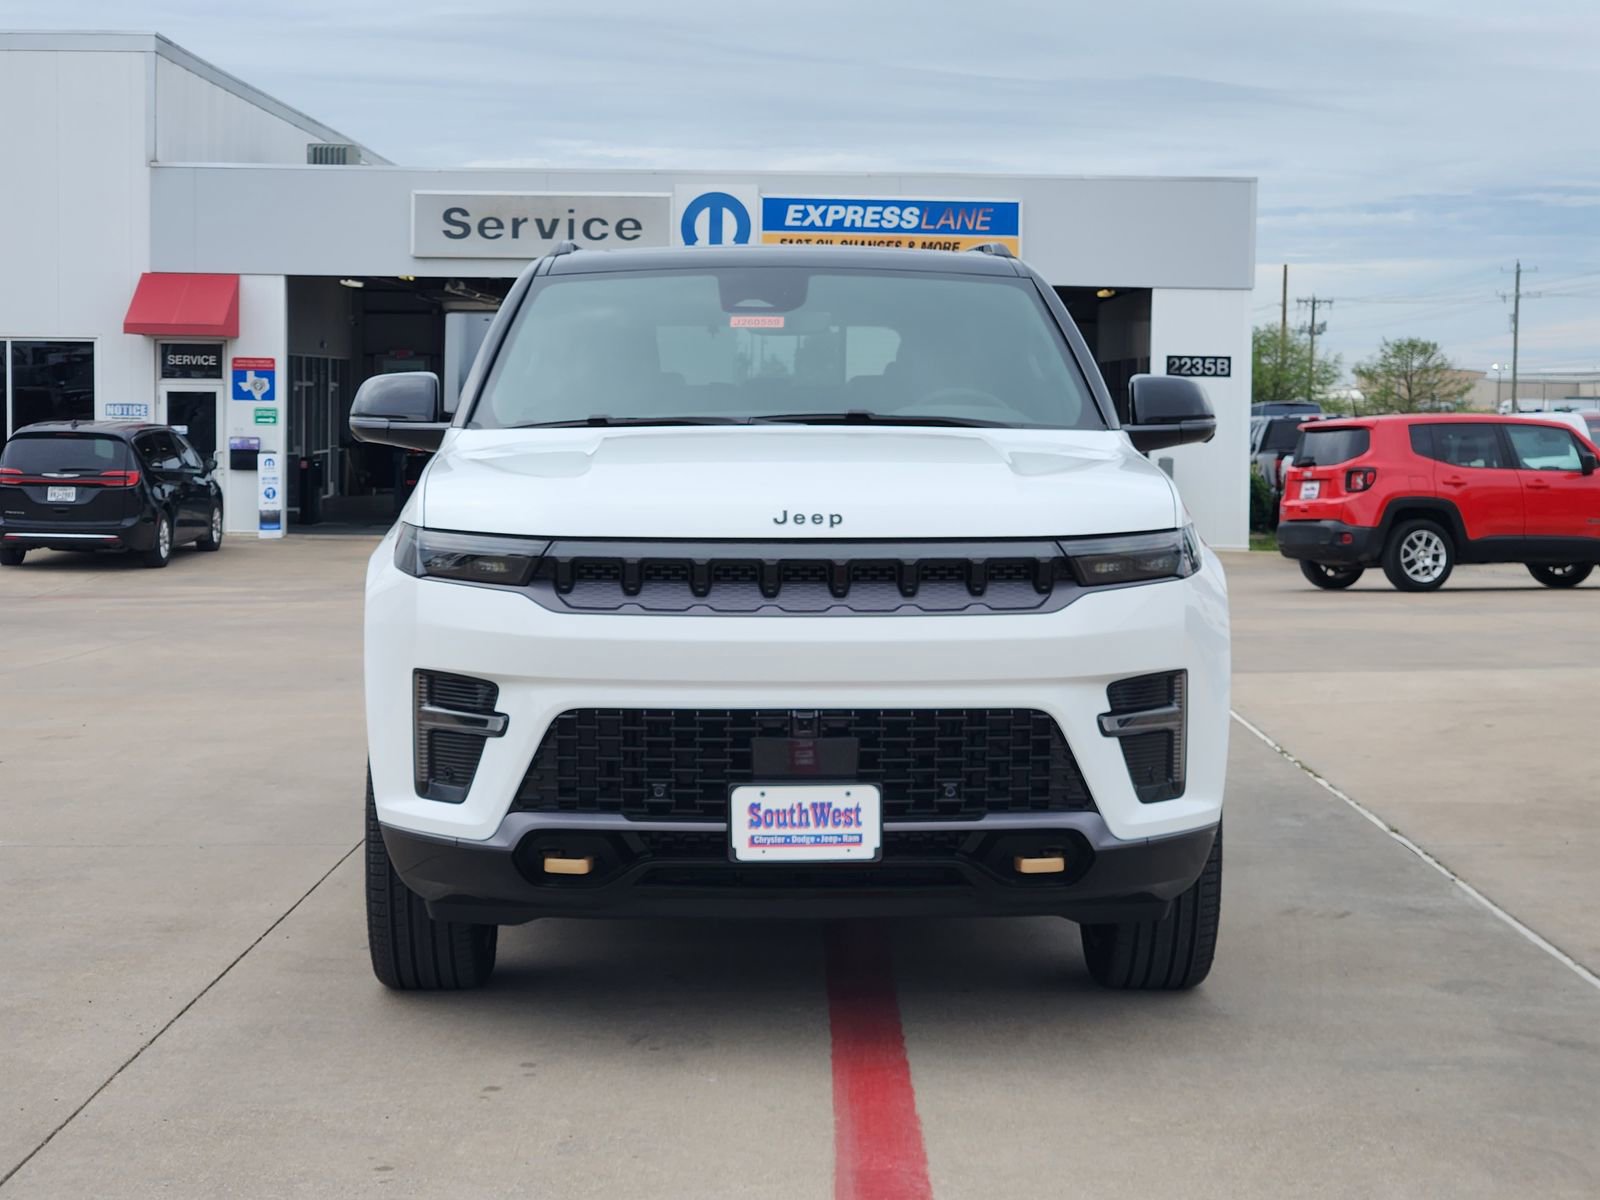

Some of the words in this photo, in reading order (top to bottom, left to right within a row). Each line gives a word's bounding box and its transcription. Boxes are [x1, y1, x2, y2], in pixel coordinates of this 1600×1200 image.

[441, 207, 643, 240] Service
[167, 355, 217, 366] SERVICE
[106, 404, 147, 416] NOTICE
[773, 510, 843, 528] Jeep
[748, 801, 863, 829] SouthWest
[753, 835, 785, 844] Chrysler
[791, 835, 815, 845] Dodge
[820, 835, 838, 844] Jeep
[842, 835, 860, 843] Ram
